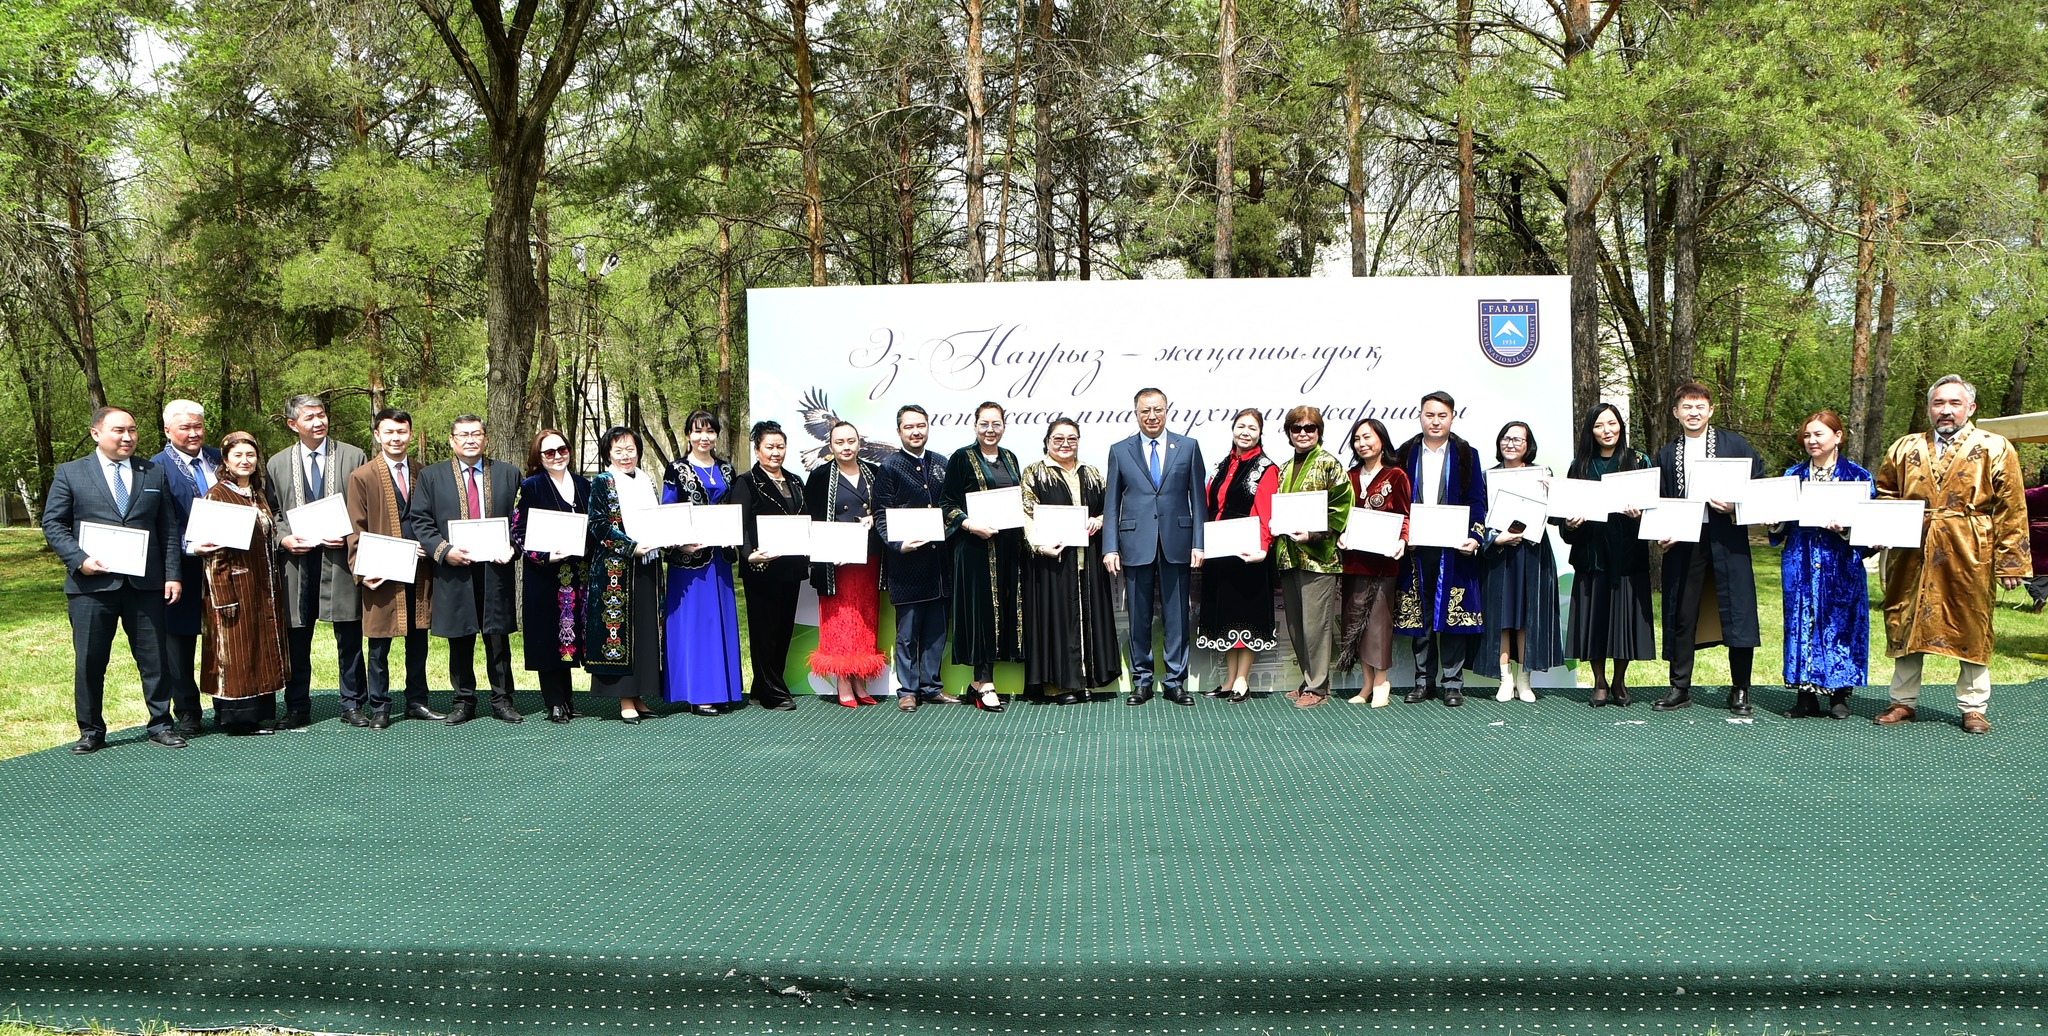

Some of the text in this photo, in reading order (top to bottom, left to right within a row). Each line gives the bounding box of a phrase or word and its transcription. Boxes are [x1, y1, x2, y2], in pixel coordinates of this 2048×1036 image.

[1488, 305, 1529, 313] FARABI
[1487, 347, 1521, 363] NATIONAL
[1522, 317, 1535, 357] UNIVERSITY
[1154, 345, 1382, 395] жаңашылдық
